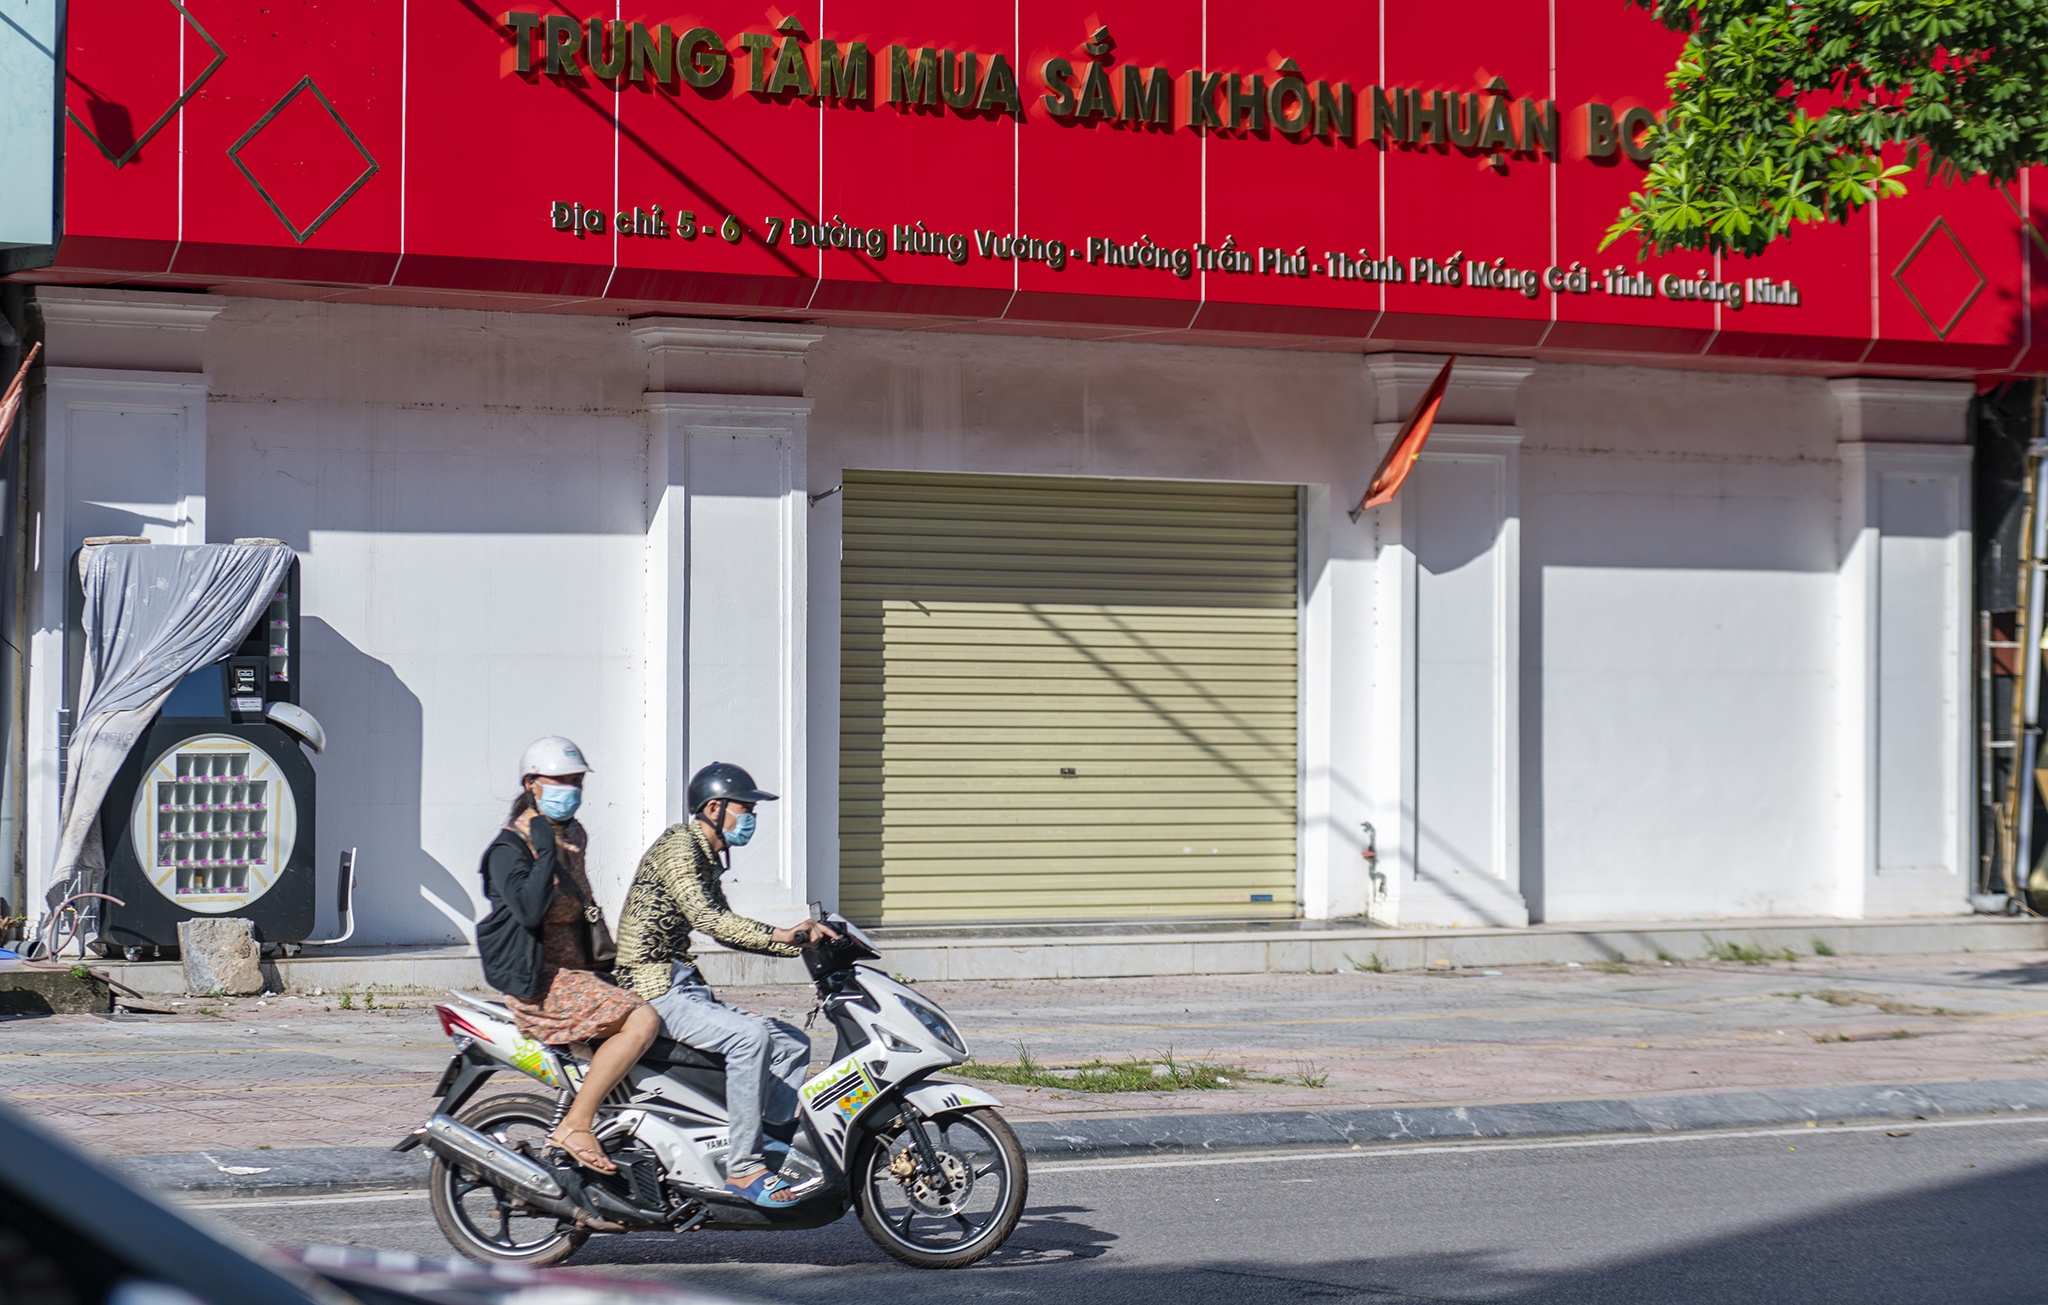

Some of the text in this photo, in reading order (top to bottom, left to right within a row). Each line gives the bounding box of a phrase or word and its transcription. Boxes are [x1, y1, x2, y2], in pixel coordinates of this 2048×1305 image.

[503, 11, 727, 88] TRUNG
[739, 16, 867, 100] TÂM
[888, 44, 1021, 112] MUA
[1039, 25, 1169, 123] SẮM
[1187, 57, 1353, 138] KHÔN
[1373, 76, 1557, 166] NHUẬN
[550, 201, 603, 236] Địa
[614, 204, 668, 236] chỉ:
[677, 210, 696, 238] 5
[721, 214, 741, 241] 6
[765, 216, 782, 243] 7
[789, 215, 886, 257] Đường
[894, 220, 967, 262] Hùng
[974, 229, 1065, 268] Vương
[1087, 234, 1191, 276] Phường
[1193, 234, 1253, 271] Trần
[1258, 246, 1309, 275] Phú
[1324, 248, 1405, 281] Thành
[1410, 250, 1463, 285] Phố
[1466, 257, 1539, 297] Móng
[1543, 261, 1590, 293] Cái
[1602, 265, 1654, 296] Tỉnh
[1658, 268, 1743, 309] Quảng
[1745, 277, 1800, 305] Ninh
